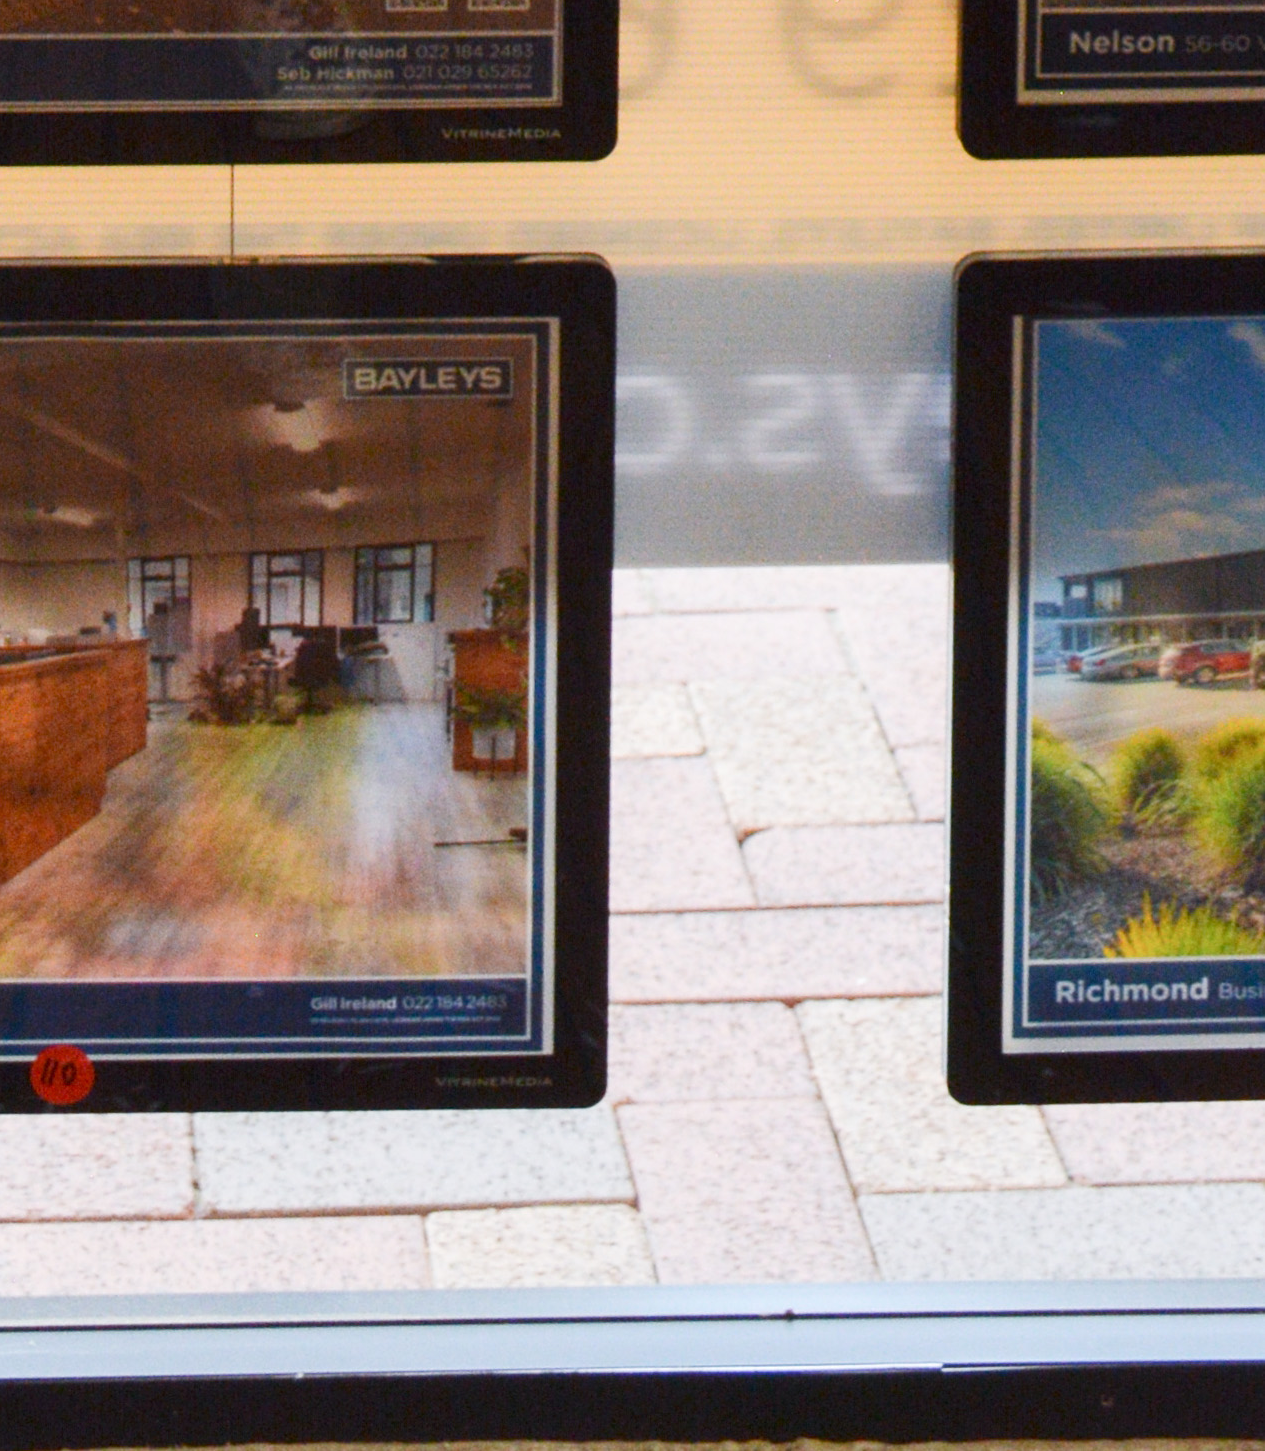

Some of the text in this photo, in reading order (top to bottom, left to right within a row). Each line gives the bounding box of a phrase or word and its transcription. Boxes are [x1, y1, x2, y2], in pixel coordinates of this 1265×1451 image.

[1069, 29, 1176, 54] Nelson
[1185, 34, 1251, 53] 56-60
[309, 45, 337, 60] Gill
[343, 45, 408, 60] Ireland
[276, 64, 533, 81] Seb Hickman 021 029 65262
[354, 366, 502, 391] BAYLEYS
[1055, 976, 1209, 1004] Richmond
[310, 997, 337, 1011] Gill
[340, 997, 397, 1011] Ireland
[402, 996, 434, 1010] 022
[437, 995, 463, 1009] 184
